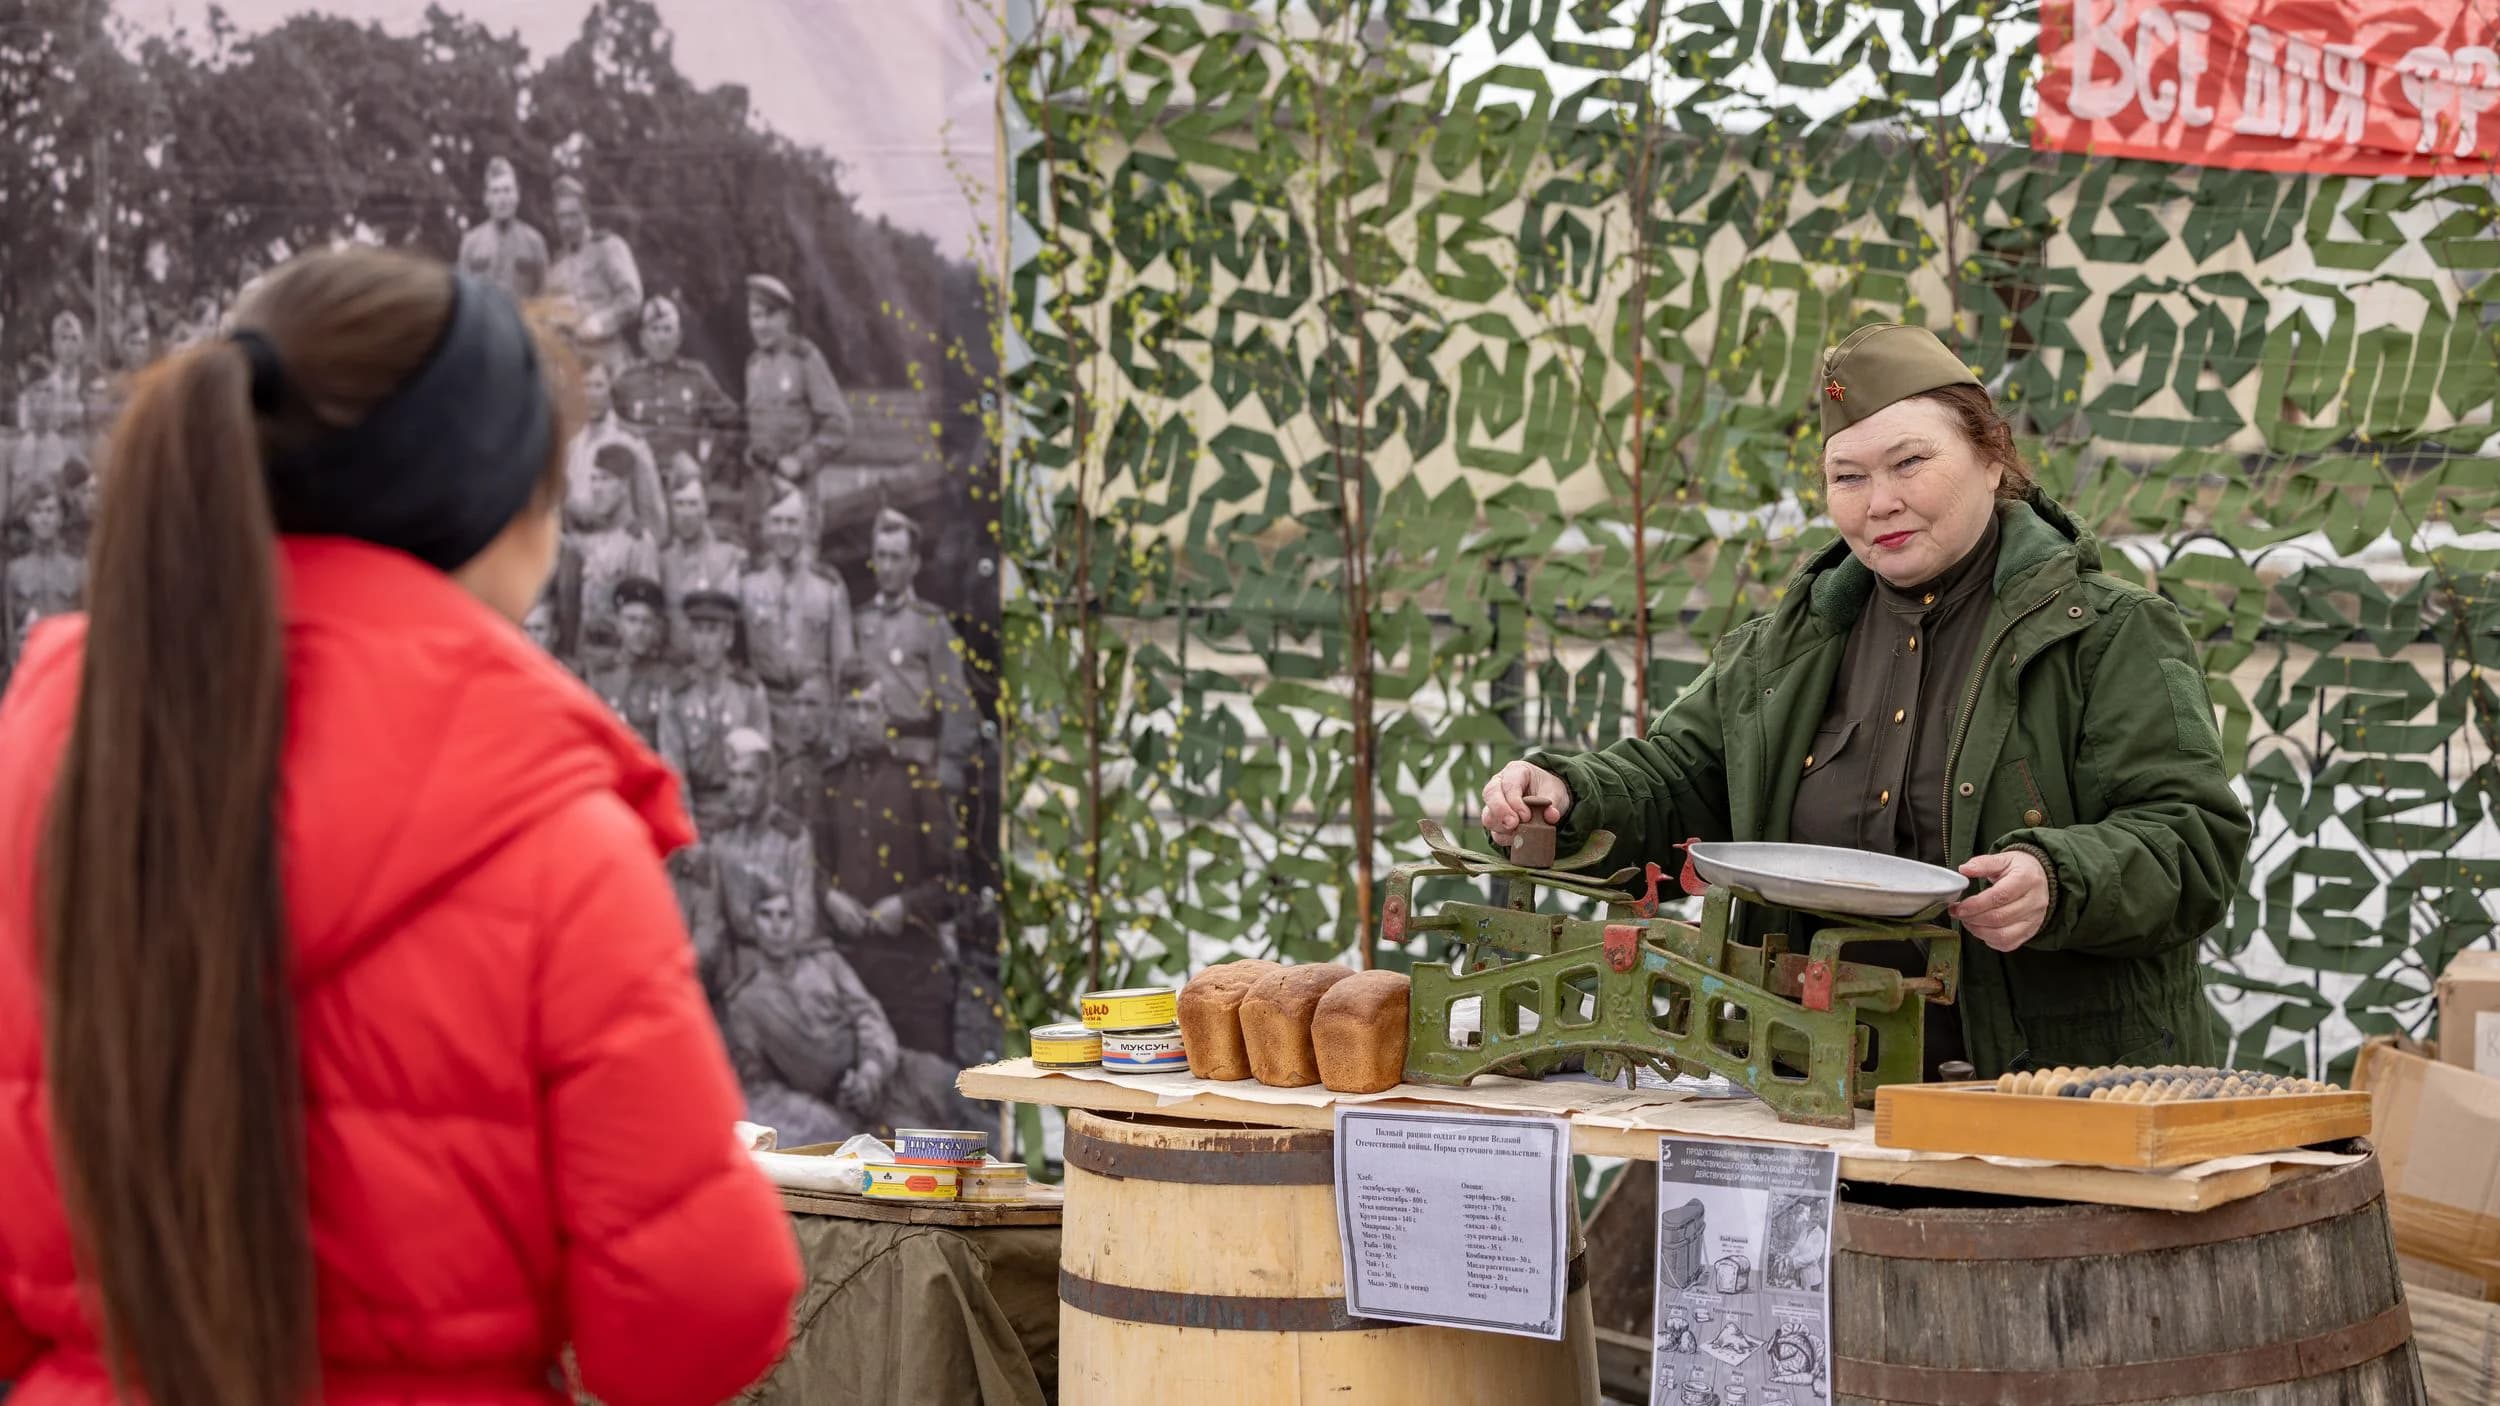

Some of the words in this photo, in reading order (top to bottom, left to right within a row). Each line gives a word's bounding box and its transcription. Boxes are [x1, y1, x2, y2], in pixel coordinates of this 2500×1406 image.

[2233, 24, 2366, 145] ДЛЯ
[1376, 1128, 1402, 1137] Полный
[1406, 1131, 1431, 1140] рацион
[1433, 1132, 1455, 1140] солдат
[1491, 1135, 1521, 1144] Великой
[1356, 1138, 1406, 1150] Отечественной
[1408, 1143, 1431, 1151] войны.
[1433, 1143, 1457, 1153] Норма
[1459, 1146, 1493, 1156] суточного
